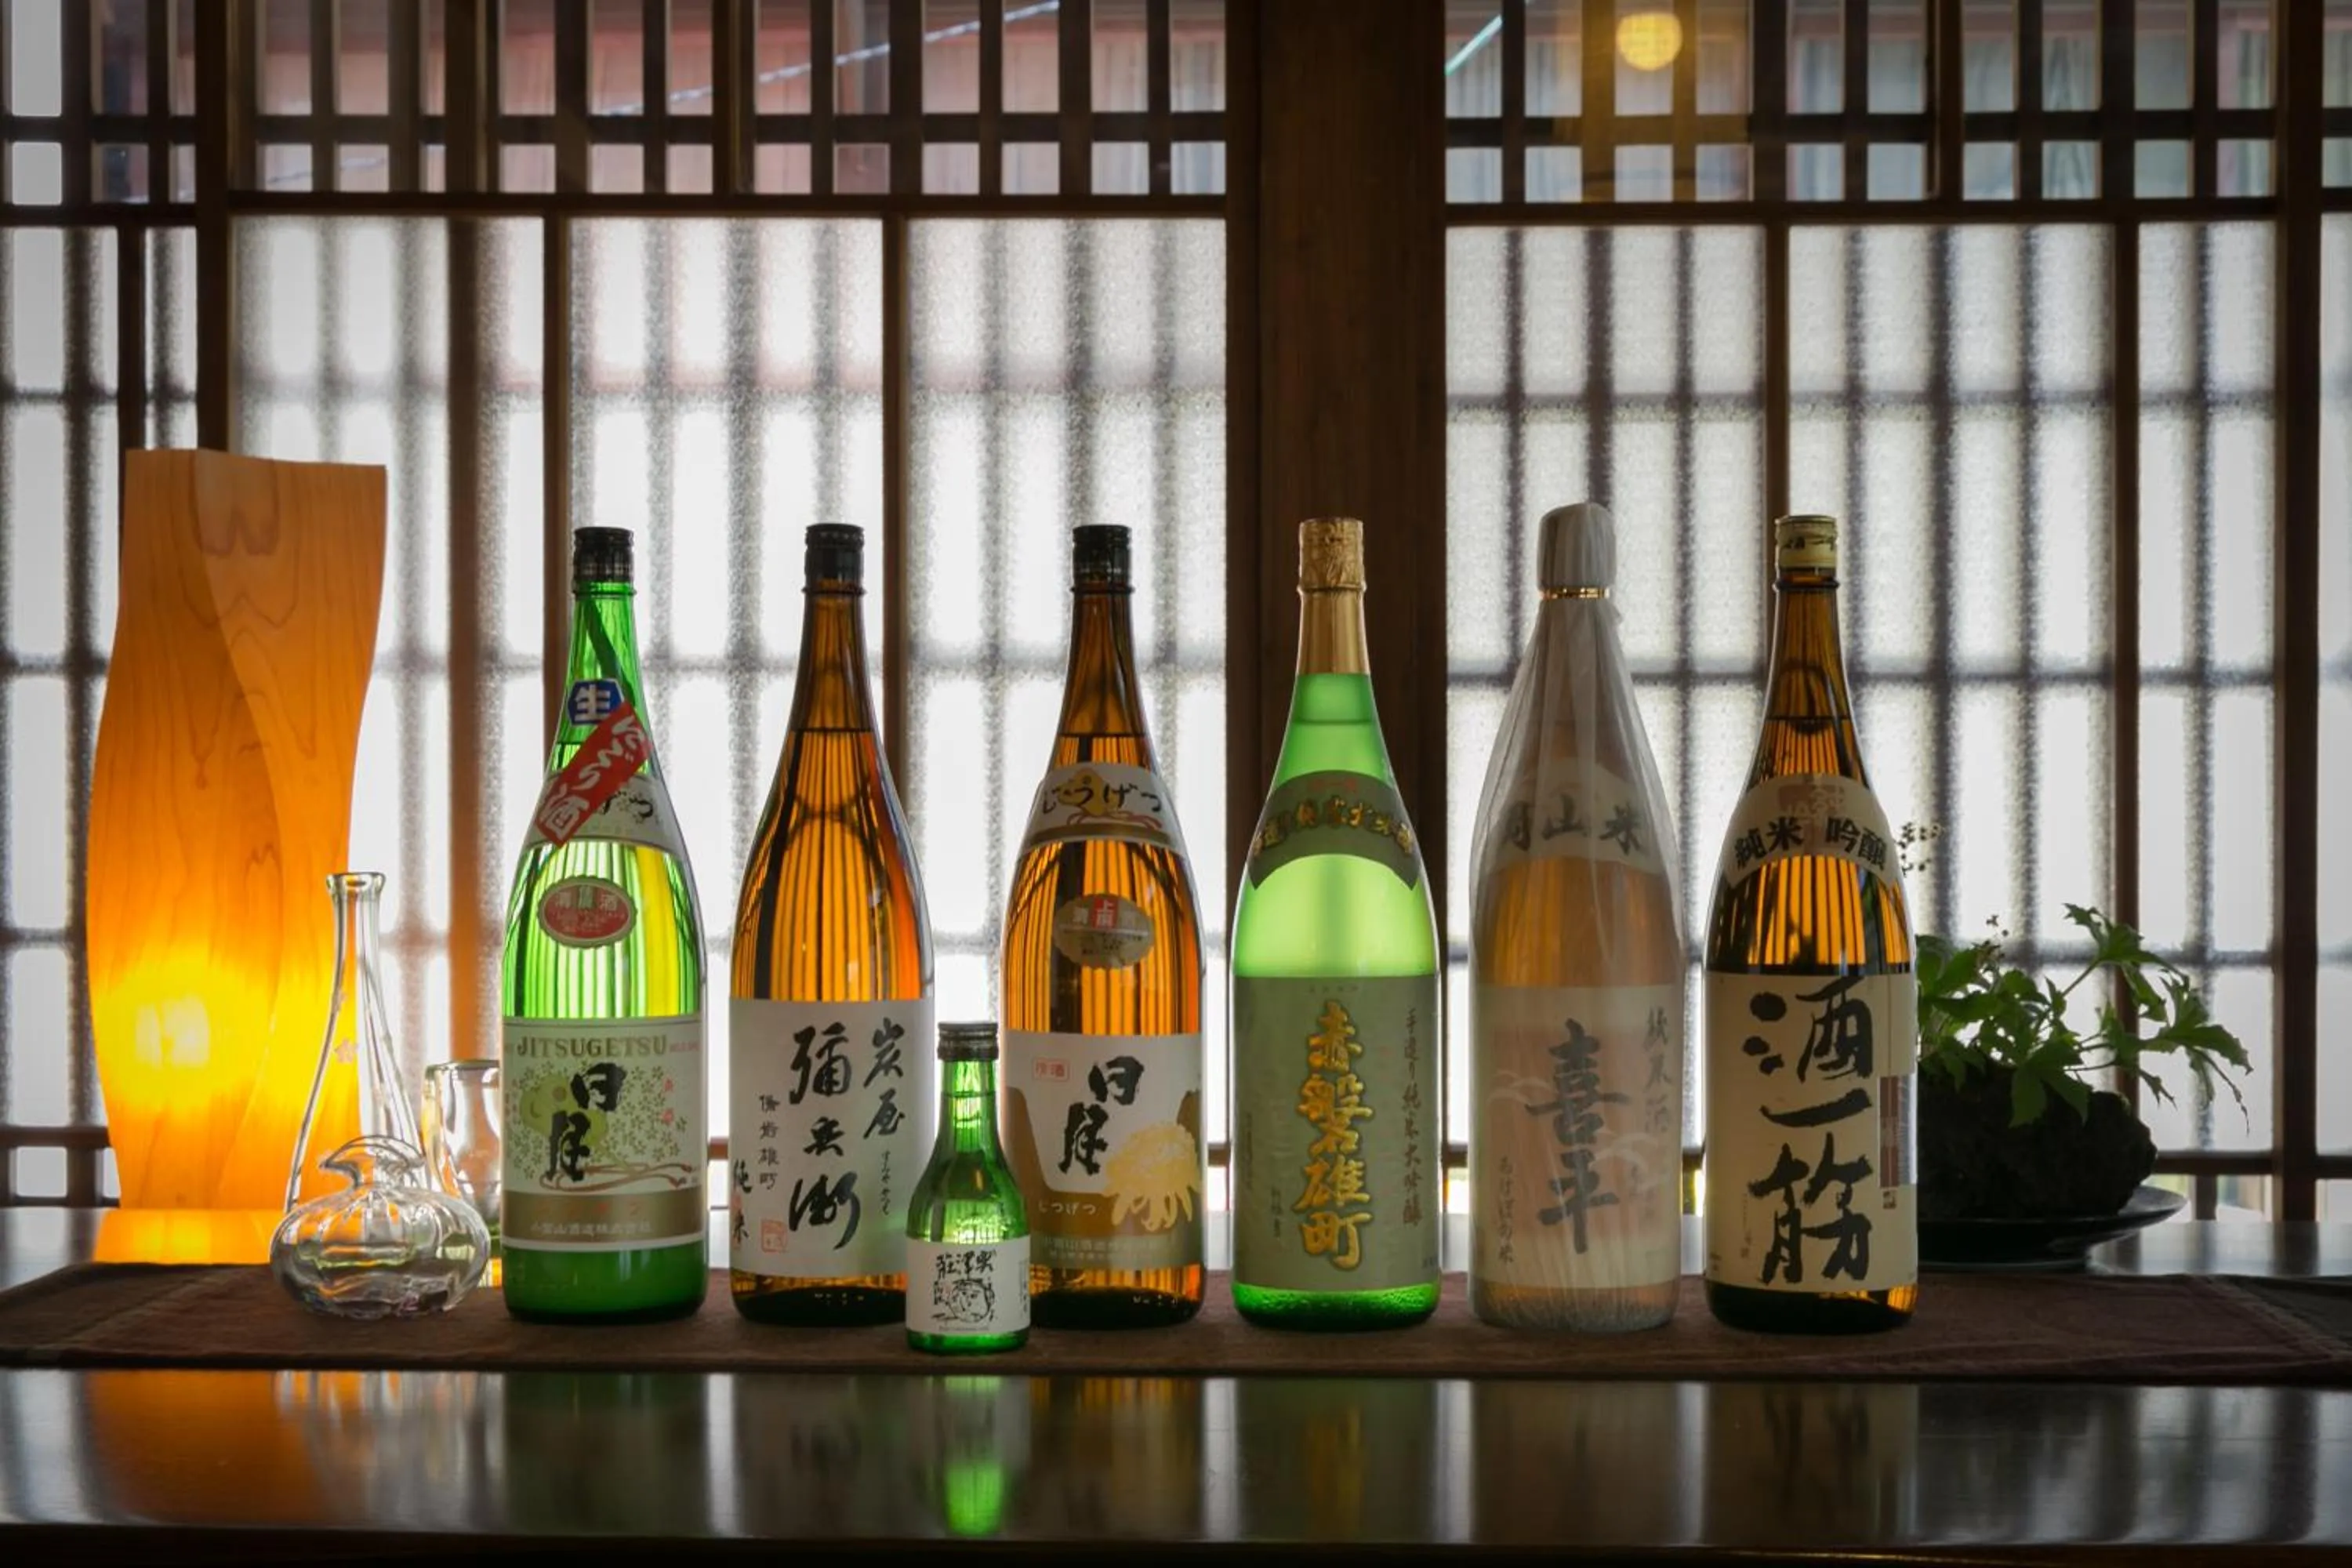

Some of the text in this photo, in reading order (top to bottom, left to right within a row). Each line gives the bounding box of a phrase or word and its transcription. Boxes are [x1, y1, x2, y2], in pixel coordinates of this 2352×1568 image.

[573, 684, 612, 722] 生
[539, 715, 648, 840] にごり酒
[516, 1035, 666, 1058] JITSUGETSU
[863, 1017, 906, 1139] 炭屋
[759, 1094, 781, 1190] 備前雄町
[1525, 1018, 1632, 1254] 喜平
[1742, 975, 1874, 1286] 酒一筋
